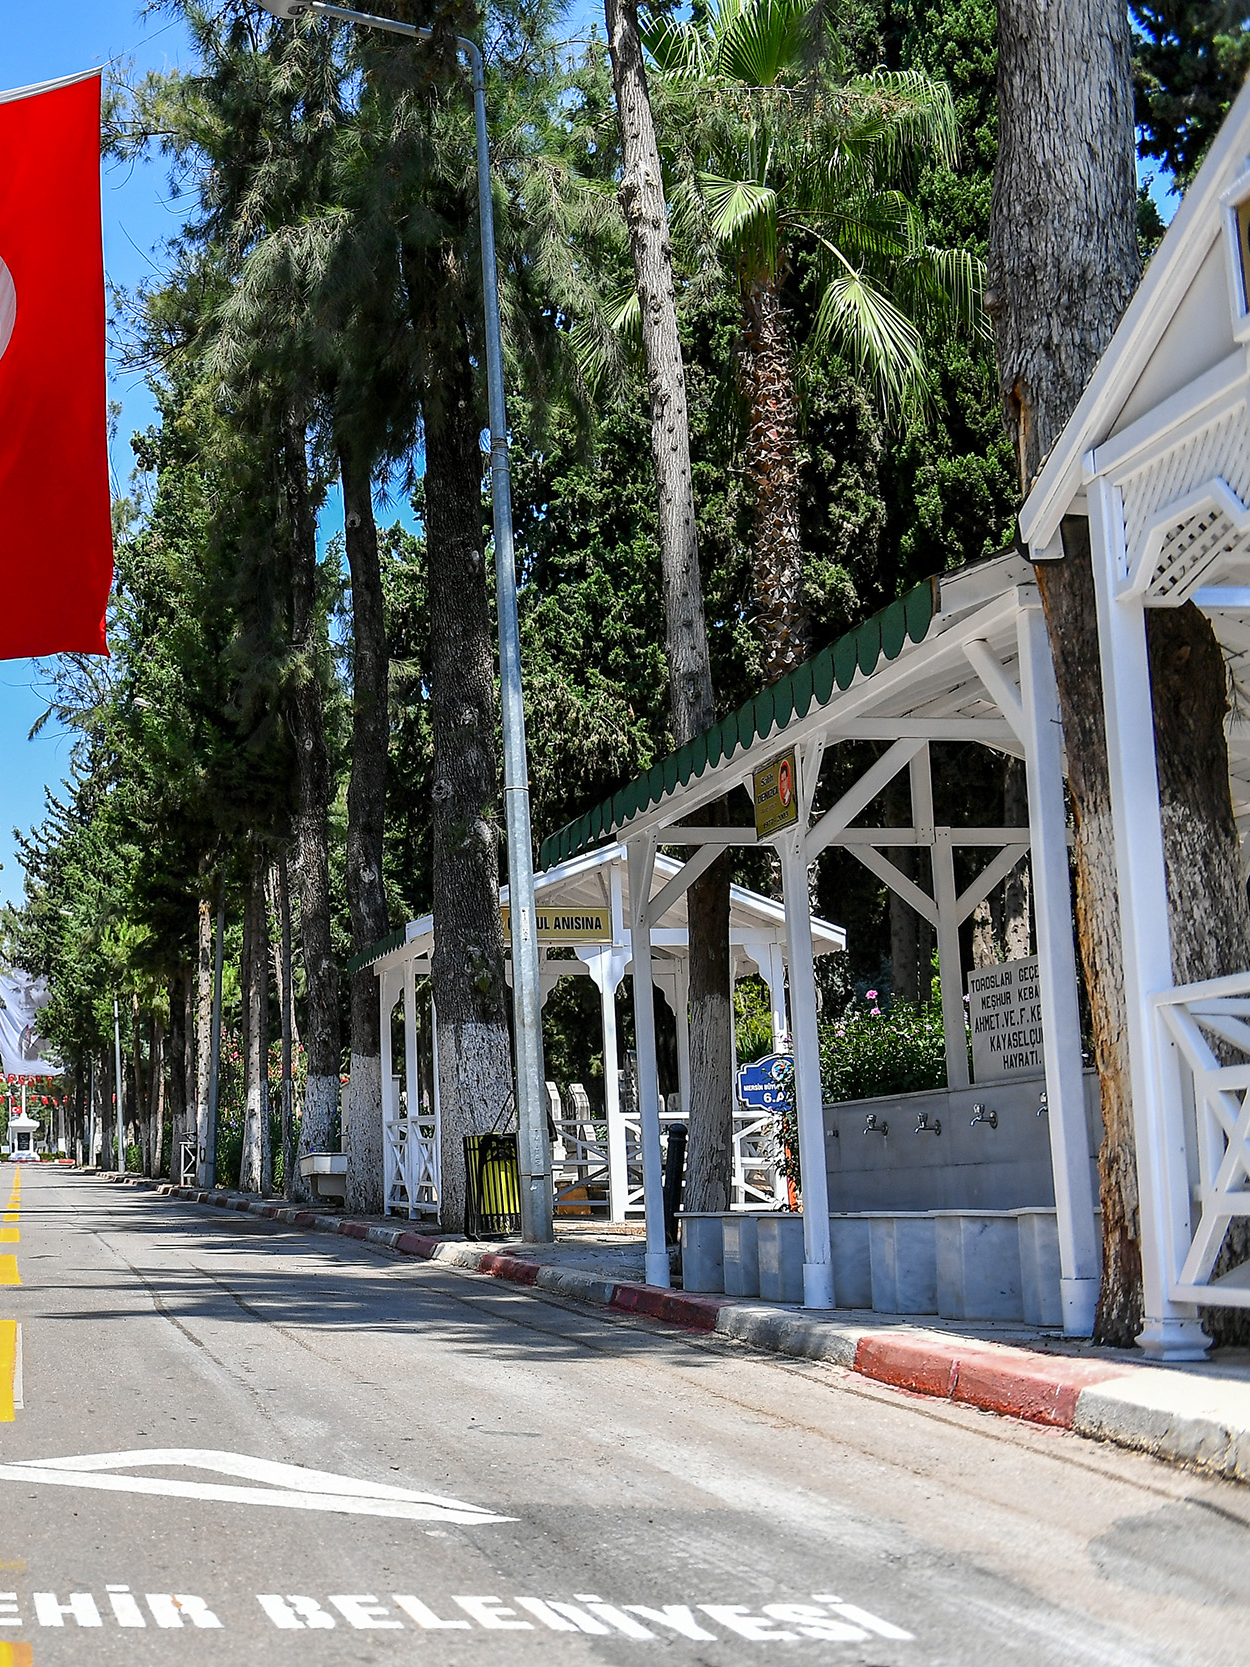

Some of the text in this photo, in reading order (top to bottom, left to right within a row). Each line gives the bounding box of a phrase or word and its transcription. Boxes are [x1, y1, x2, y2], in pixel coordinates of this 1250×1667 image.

[553, 916, 602, 930] ANISINA
[971, 971, 1012, 993] TOROSLARI
[1018, 985, 1041, 1003] KEBA
[990, 1027, 1044, 1052] KAYASELÇU
[255, 1593, 917, 1641] BELEDİYESİ
